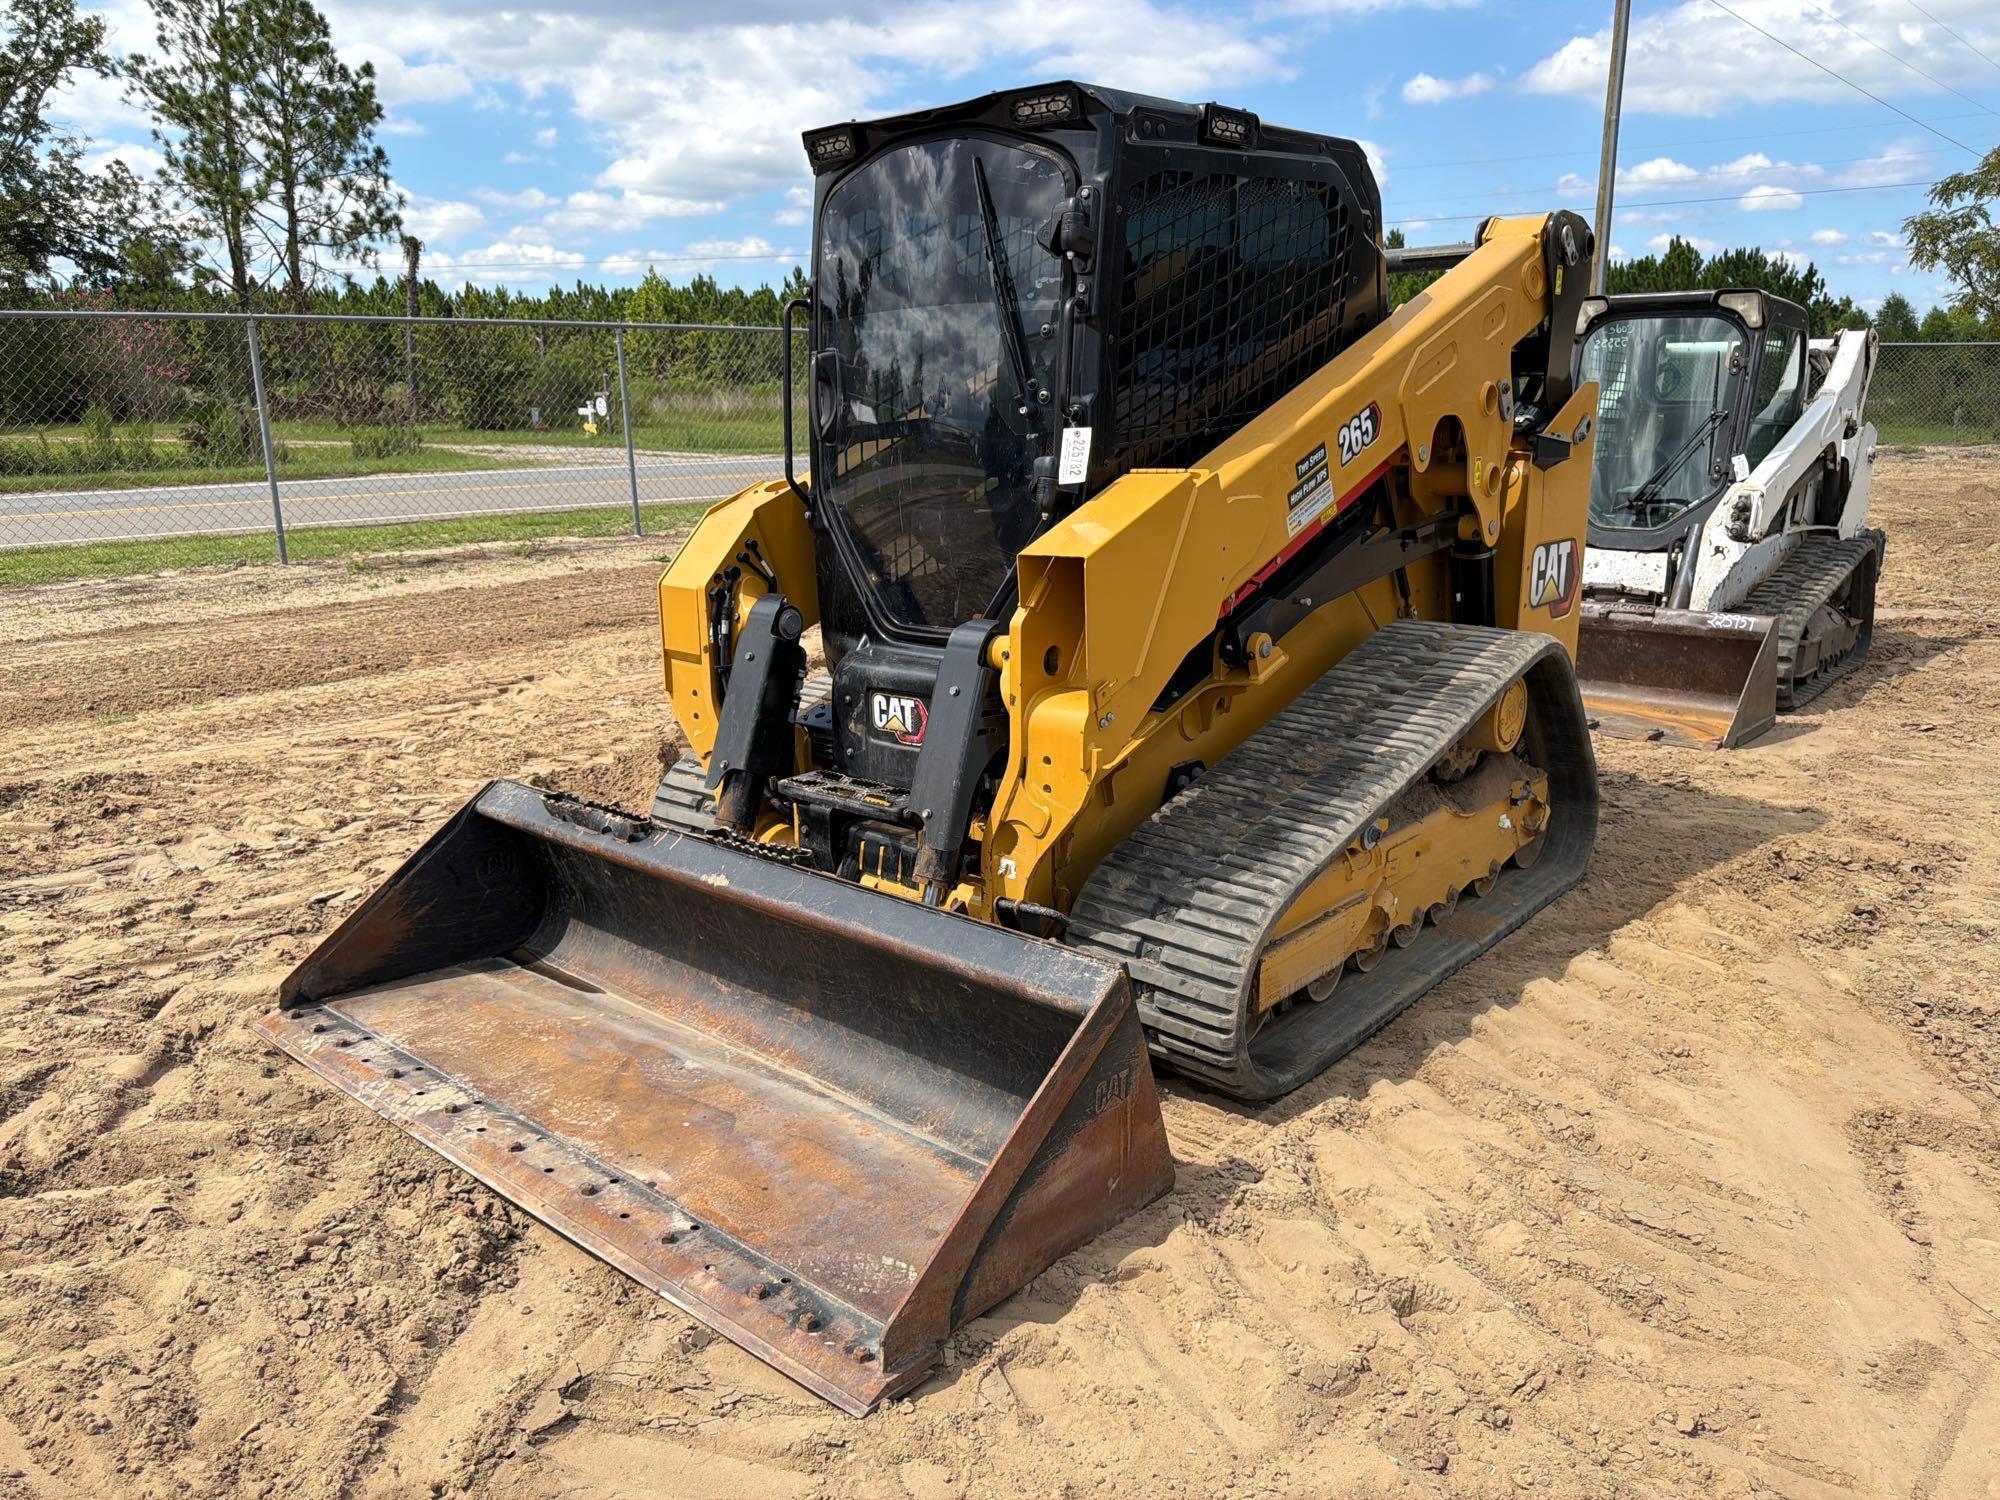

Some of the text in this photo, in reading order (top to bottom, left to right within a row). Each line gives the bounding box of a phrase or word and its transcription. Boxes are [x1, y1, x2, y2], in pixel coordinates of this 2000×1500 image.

[1339, 407, 1373, 465] 265
[1530, 540, 1572, 606] CAT
[873, 694, 915, 734] CAT
[1095, 1068, 1130, 1114] CAT
